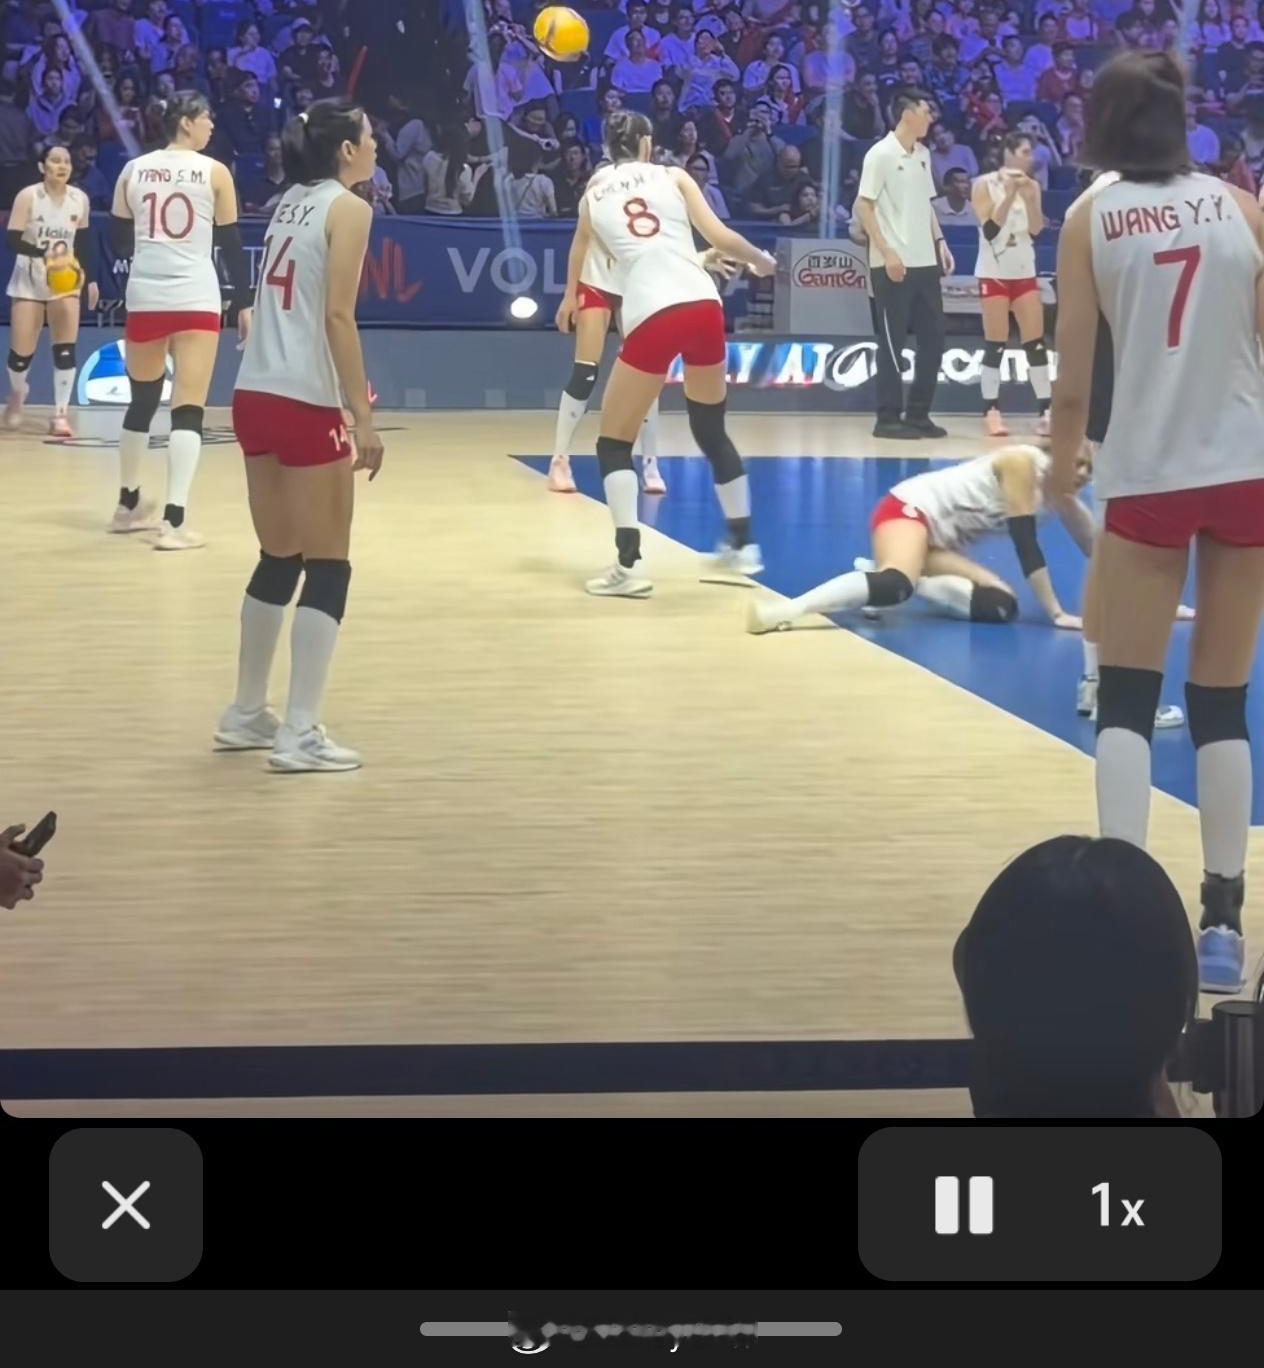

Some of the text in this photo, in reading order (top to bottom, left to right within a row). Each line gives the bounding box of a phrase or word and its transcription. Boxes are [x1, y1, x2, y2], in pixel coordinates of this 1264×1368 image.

[142, 192, 194, 239] 10
[623, 197, 660, 238] 8
[1102, 194, 1232, 242] WANG Y.Y.
[259, 234, 296, 310] 14
[360, 237, 424, 303] NL
[1153, 245, 1201, 348] 7
